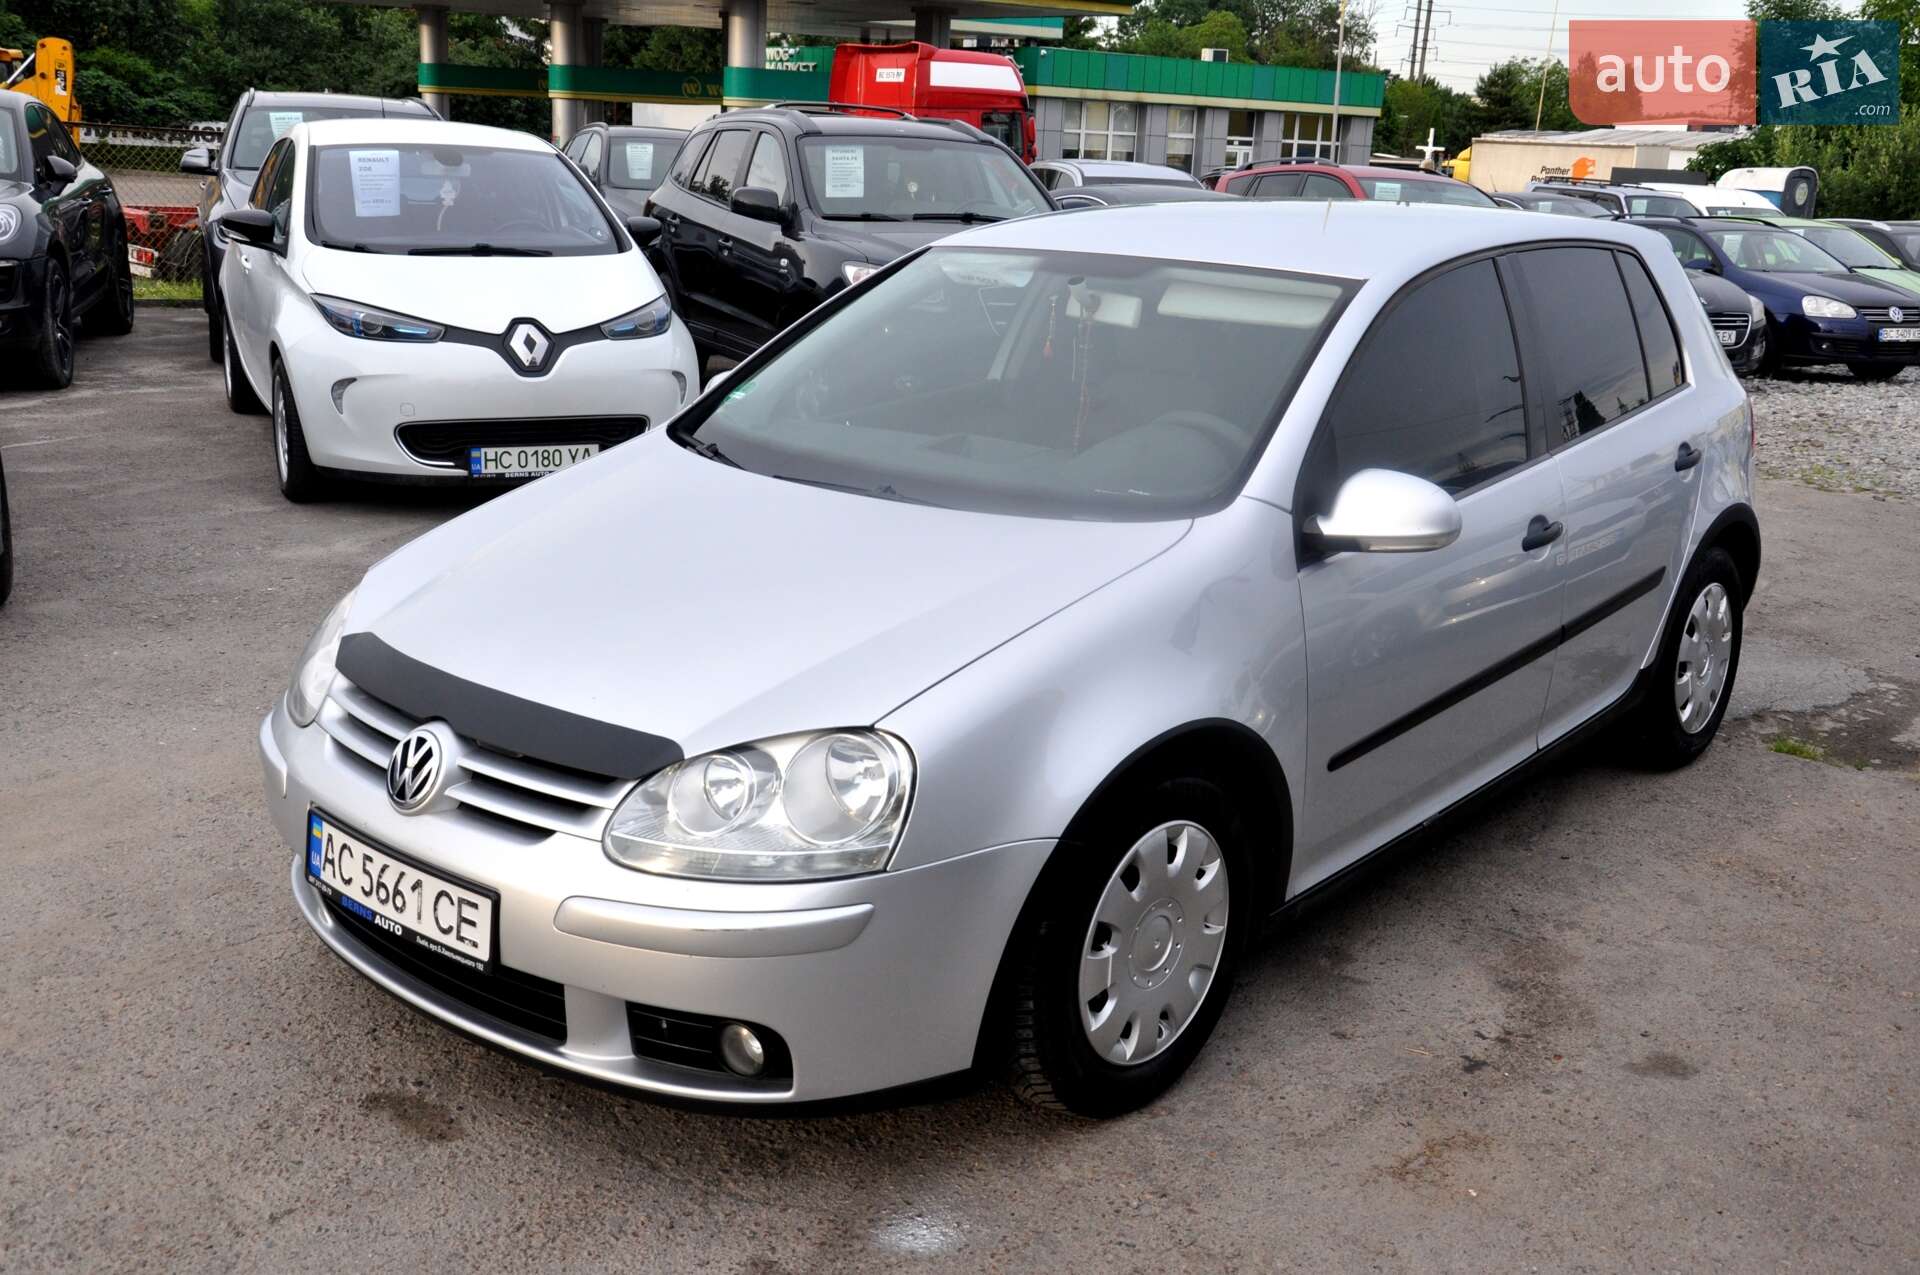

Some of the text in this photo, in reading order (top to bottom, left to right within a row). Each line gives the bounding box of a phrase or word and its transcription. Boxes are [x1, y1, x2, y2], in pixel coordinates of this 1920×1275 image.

[765, 47, 789, 61] WOG
[1540, 165, 1571, 175] Panther
[484, 450, 512, 469] HC
[517, 448, 562, 469] 0180
[311, 850, 321, 869] UA
[322, 833, 479, 949] AC 5661 CE
[341, 896, 403, 936] BERNS AUTO
